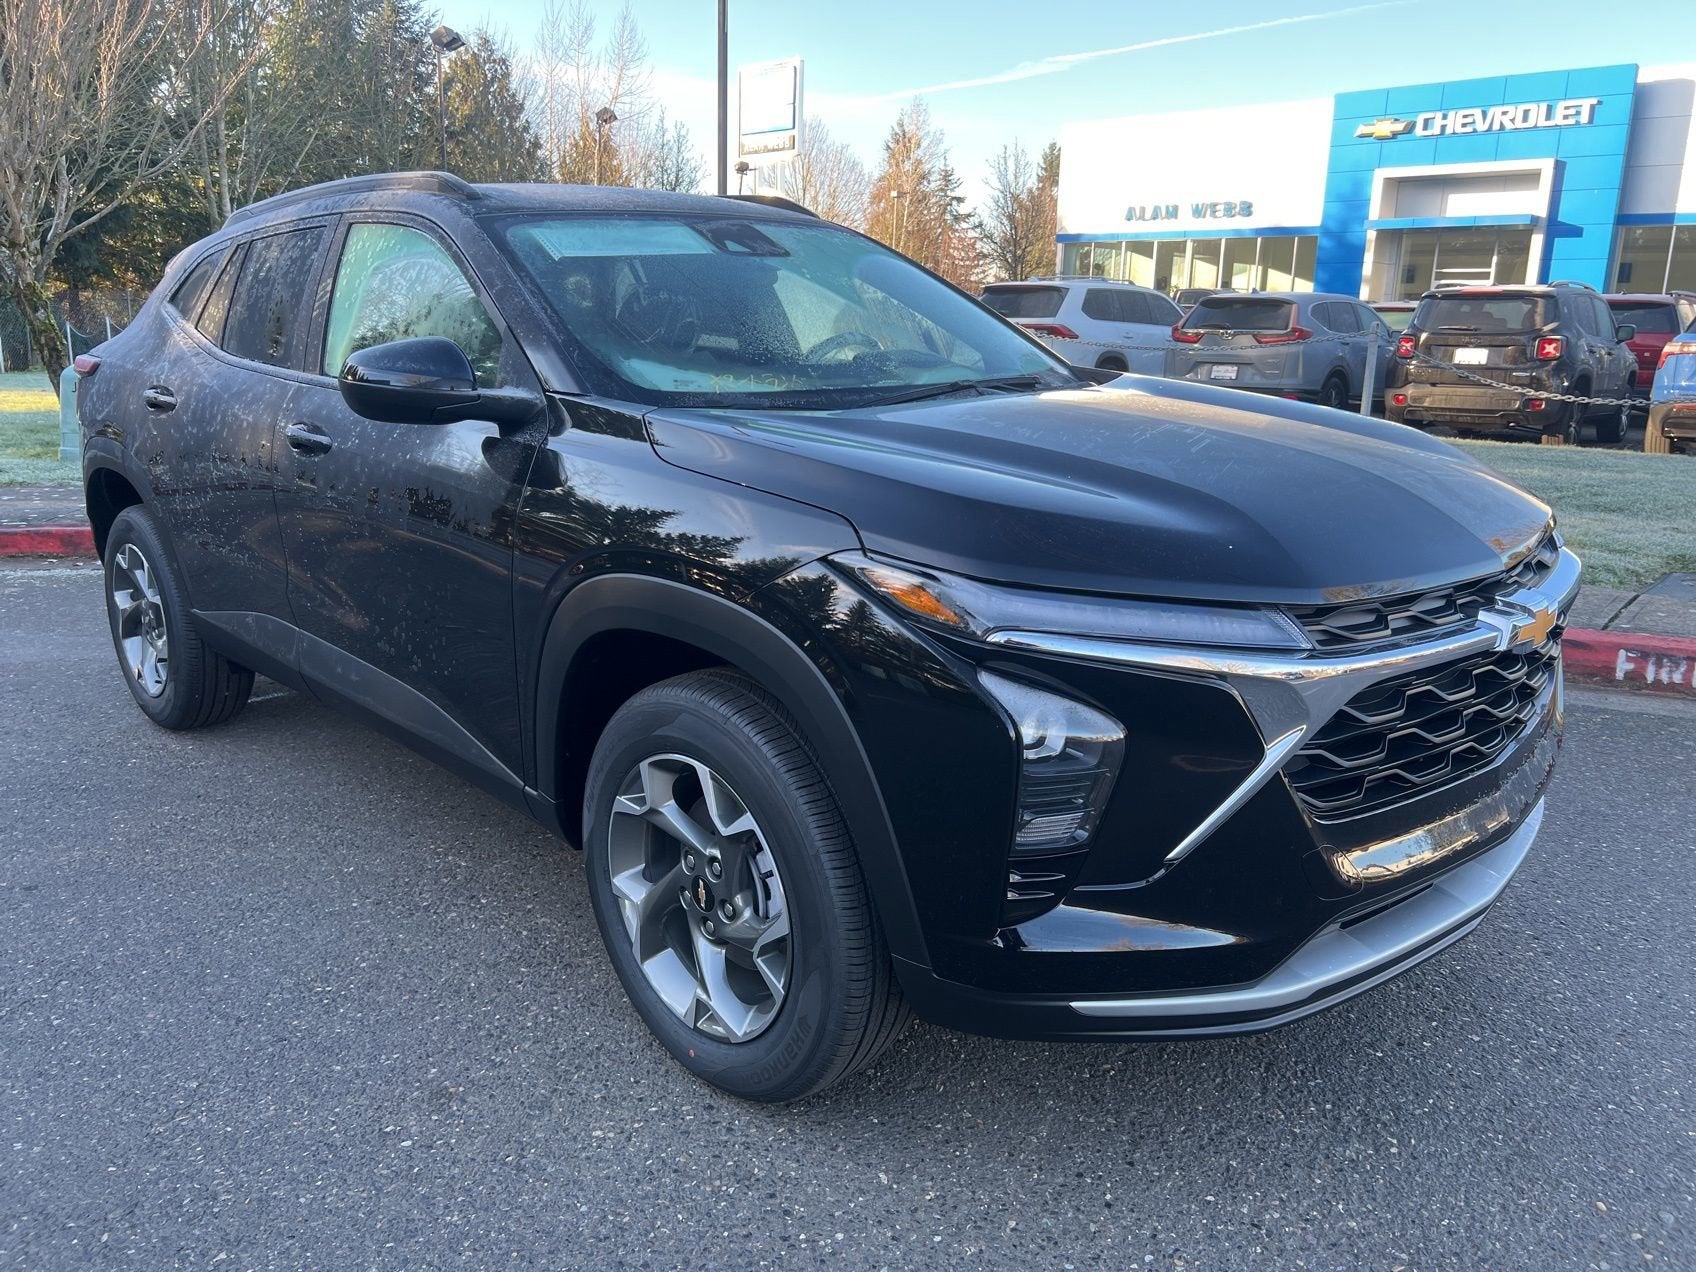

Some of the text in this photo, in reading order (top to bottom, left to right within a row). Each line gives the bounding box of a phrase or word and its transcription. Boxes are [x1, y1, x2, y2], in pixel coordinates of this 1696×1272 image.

[1415, 97, 1601, 137] CHEVROLET
[1125, 200, 1253, 221] ALAN WEBB
[1616, 648, 1696, 688] FIR
